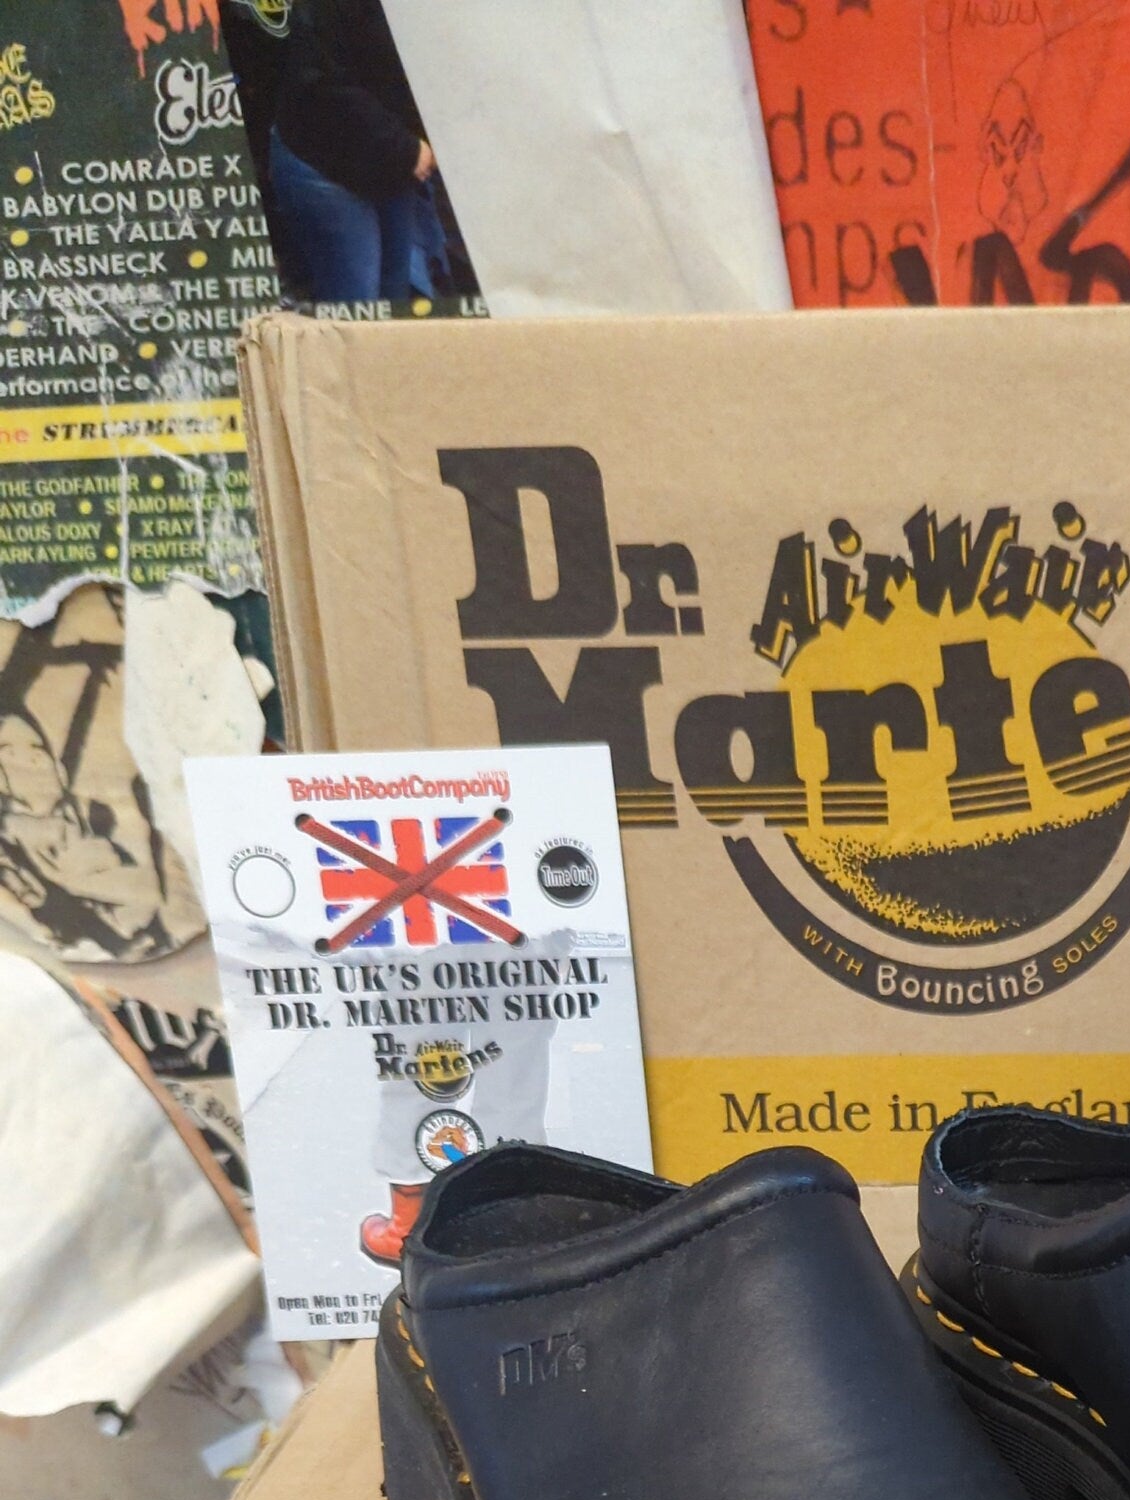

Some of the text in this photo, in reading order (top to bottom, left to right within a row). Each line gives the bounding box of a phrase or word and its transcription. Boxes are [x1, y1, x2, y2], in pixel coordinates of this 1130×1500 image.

[61, 154, 242, 184] COMRADE X
[3, 191, 137, 218] BABYLON
[147, 188, 203, 212] DUB
[51, 223, 99, 246] THE
[106, 214, 197, 244] YALLA
[3, 252, 167, 280] BRASSNECK
[170, 278, 220, 301] THE
[0, 481, 32, 498] THE
[0, 500, 57, 519] AYLOR
[0, 522, 51, 543] ALOUS
[57, 521, 101, 541] DOXY
[156, 517, 194, 537] RAY
[437, 445, 706, 642] Dr.
[0, 545, 35, 564] ARK
[36, 543, 97, 562] AYLING
[130, 540, 203, 559] PEWTER
[286, 772, 512, 805] BritishBootCompany
[802, 914, 1119, 1006] WITH Bouncing SOLES
[245, 957, 609, 997] THE UK'S ORIGINAL
[266, 991, 600, 1031] DR. MARTEN SHOP
[372, 1032, 408, 1056] Dr.
[374, 1040, 503, 1082] Martens
[719, 1090, 872, 1135] Made
[890, 1093, 938, 1133] in
[277, 1296, 309, 1312] Open
[313, 1294, 342, 1310] Mon
[344, 1293, 359, 1308] to
